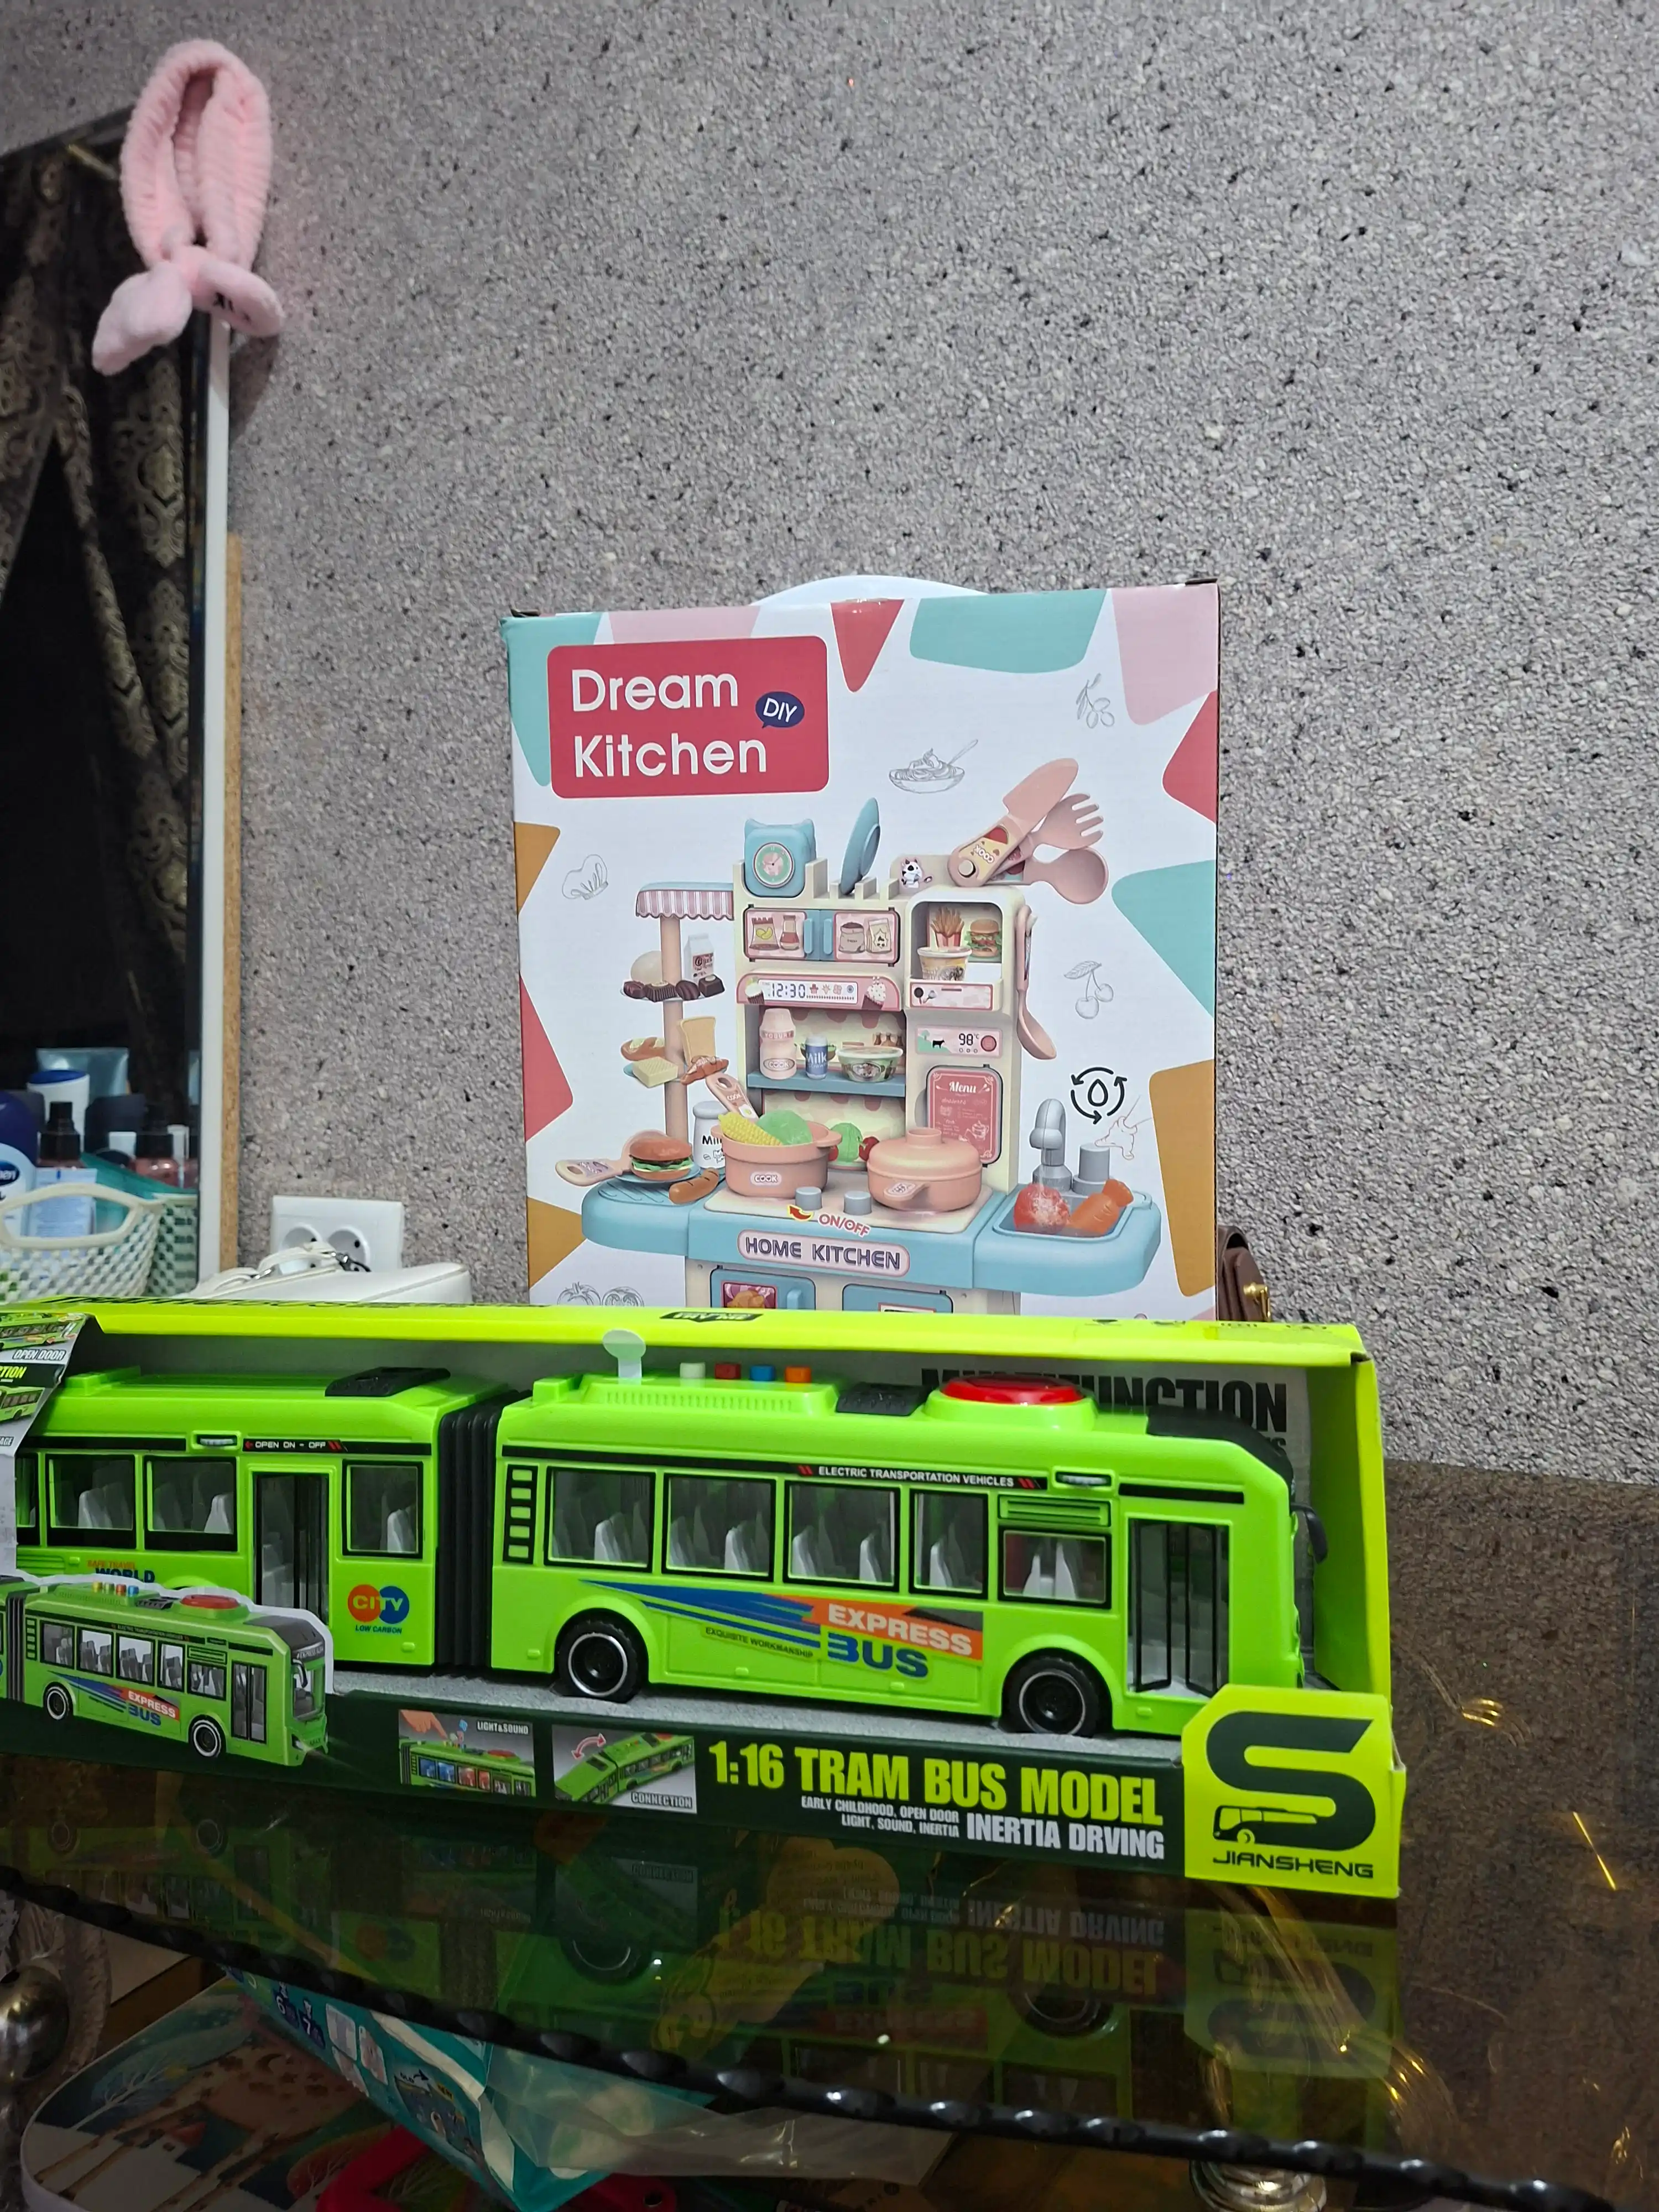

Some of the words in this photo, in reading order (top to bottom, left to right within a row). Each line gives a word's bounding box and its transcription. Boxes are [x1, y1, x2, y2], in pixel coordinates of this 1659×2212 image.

[572, 669, 738, 711] Dream
[763, 697, 797, 722] DIY
[574, 733, 766, 778] Kitchen
[772, 983, 806, 998] 12:30
[806, 1051, 827, 1063] Milk
[949, 1081, 977, 1093] Menu
[754, 1174, 778, 1183] COOK
[819, 1214, 870, 1235] ON/OFF
[745, 1237, 802, 1258] HOME
[812, 1244, 900, 1270] KITCHEN
[13, 1349, 38, 1360] OPEN
[37, 1350, 65, 1360] DOOR
[255, 1441, 279, 1449] OPEN
[818, 1466, 867, 1478] ELECTRIC
[870, 1468, 961, 1484] TRANSPORTATION
[963, 1474, 1014, 1488] VEHICLES
[353, 1595, 404, 1611] CITY
[355, 1624, 372, 1632] LOW
[372, 1626, 403, 1635] CARBON
[828, 1603, 972, 1657] EXPRESS
[705, 1626, 749, 1644] EXQUISITE
[750, 1638, 814, 1659] WORKMANSHIP
[828, 1631, 929, 1679] BUS
[128, 1690, 176, 1719] EXPRESS
[128, 1703, 161, 1726] BUS
[477, 1721, 529, 1735] LIGHT&SOUND
[708, 1741, 785, 1789] 1:16
[795, 1746, 910, 1801] TRAM
[924, 1757, 1007, 1811] BUS
[1021, 1767, 1164, 1825] MODEL
[631, 1791, 693, 1809] CONNECTION
[801, 1796, 832, 1811] EARLY
[835, 1799, 897, 1818] CHILDHOOD,
[900, 1805, 927, 1820] OPEN
[929, 1808, 960, 1823] DOOR
[842, 1813, 875, 1830] LIGHT,
[877, 1817, 916, 1834] SOUND,
[919, 1821, 960, 1838] INERTIA
[966, 1812, 1061, 1849] INERTIA
[1068, 1825, 1165, 1860] DRVING
[1213, 1850, 1374, 1878] JIANSHENG
